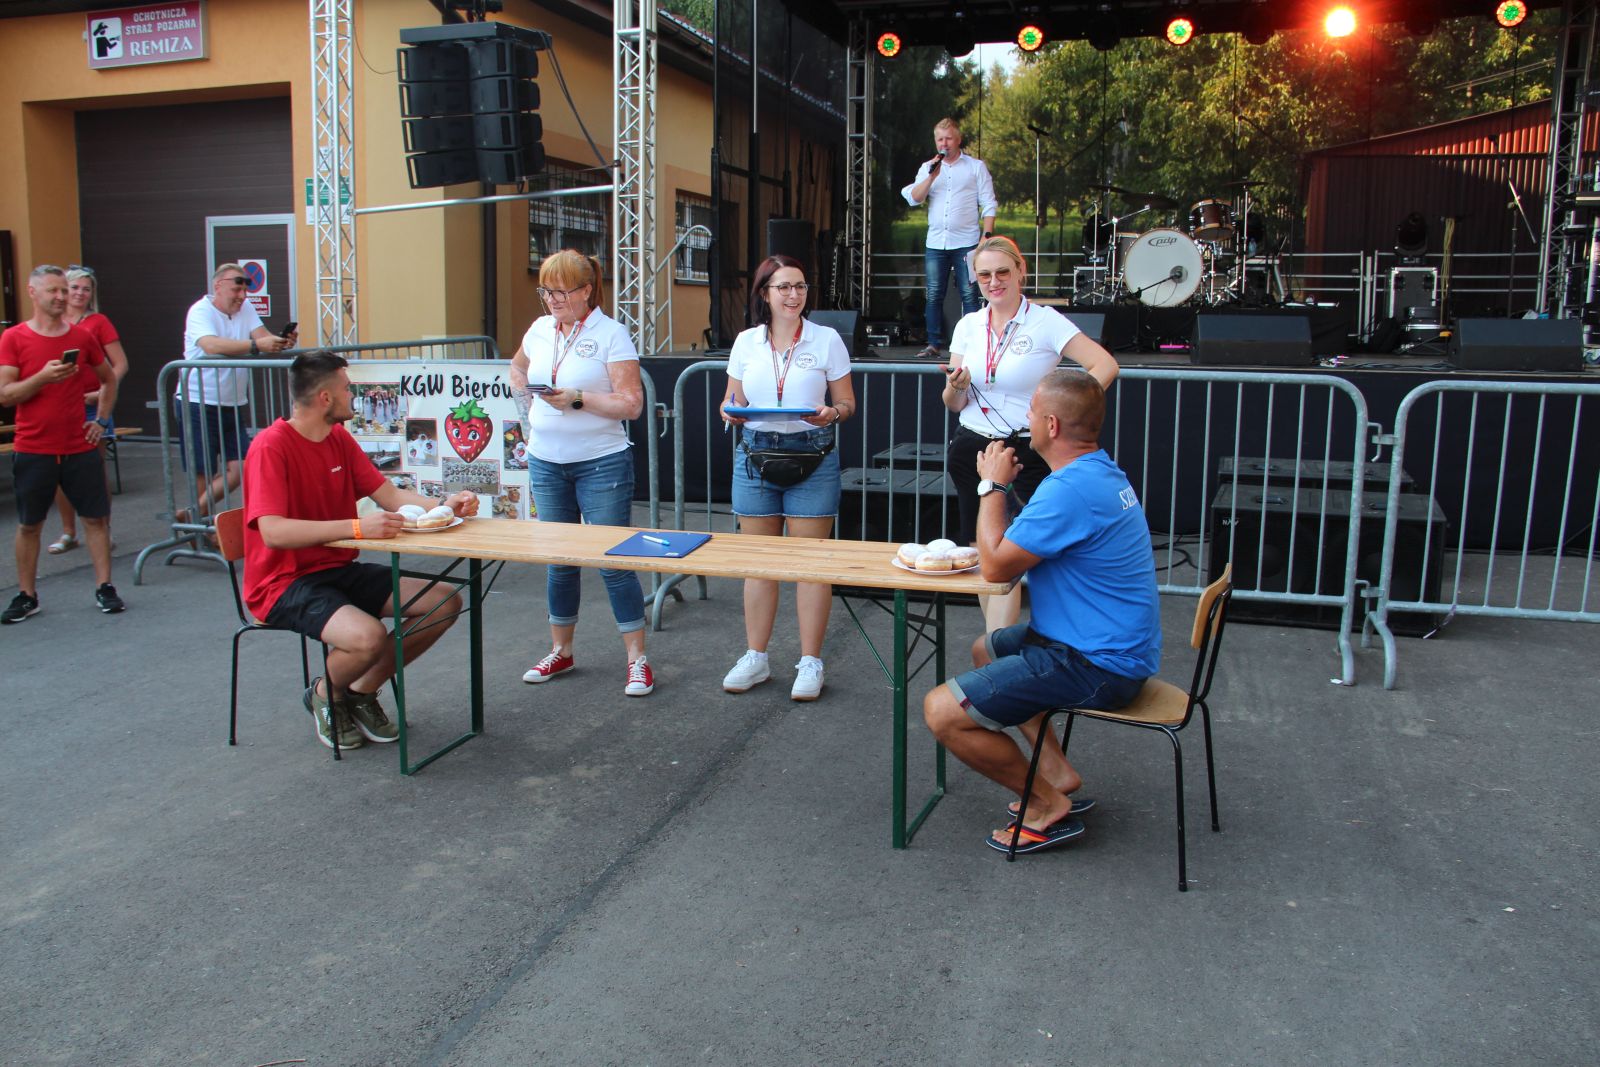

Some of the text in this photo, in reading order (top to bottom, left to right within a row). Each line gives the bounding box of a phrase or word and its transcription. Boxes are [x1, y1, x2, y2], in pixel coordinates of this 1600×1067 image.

[133, 8, 187, 22] OCHOTNICZA
[130, 36, 193, 57] REMIZA
[400, 374, 444, 398] KGW
